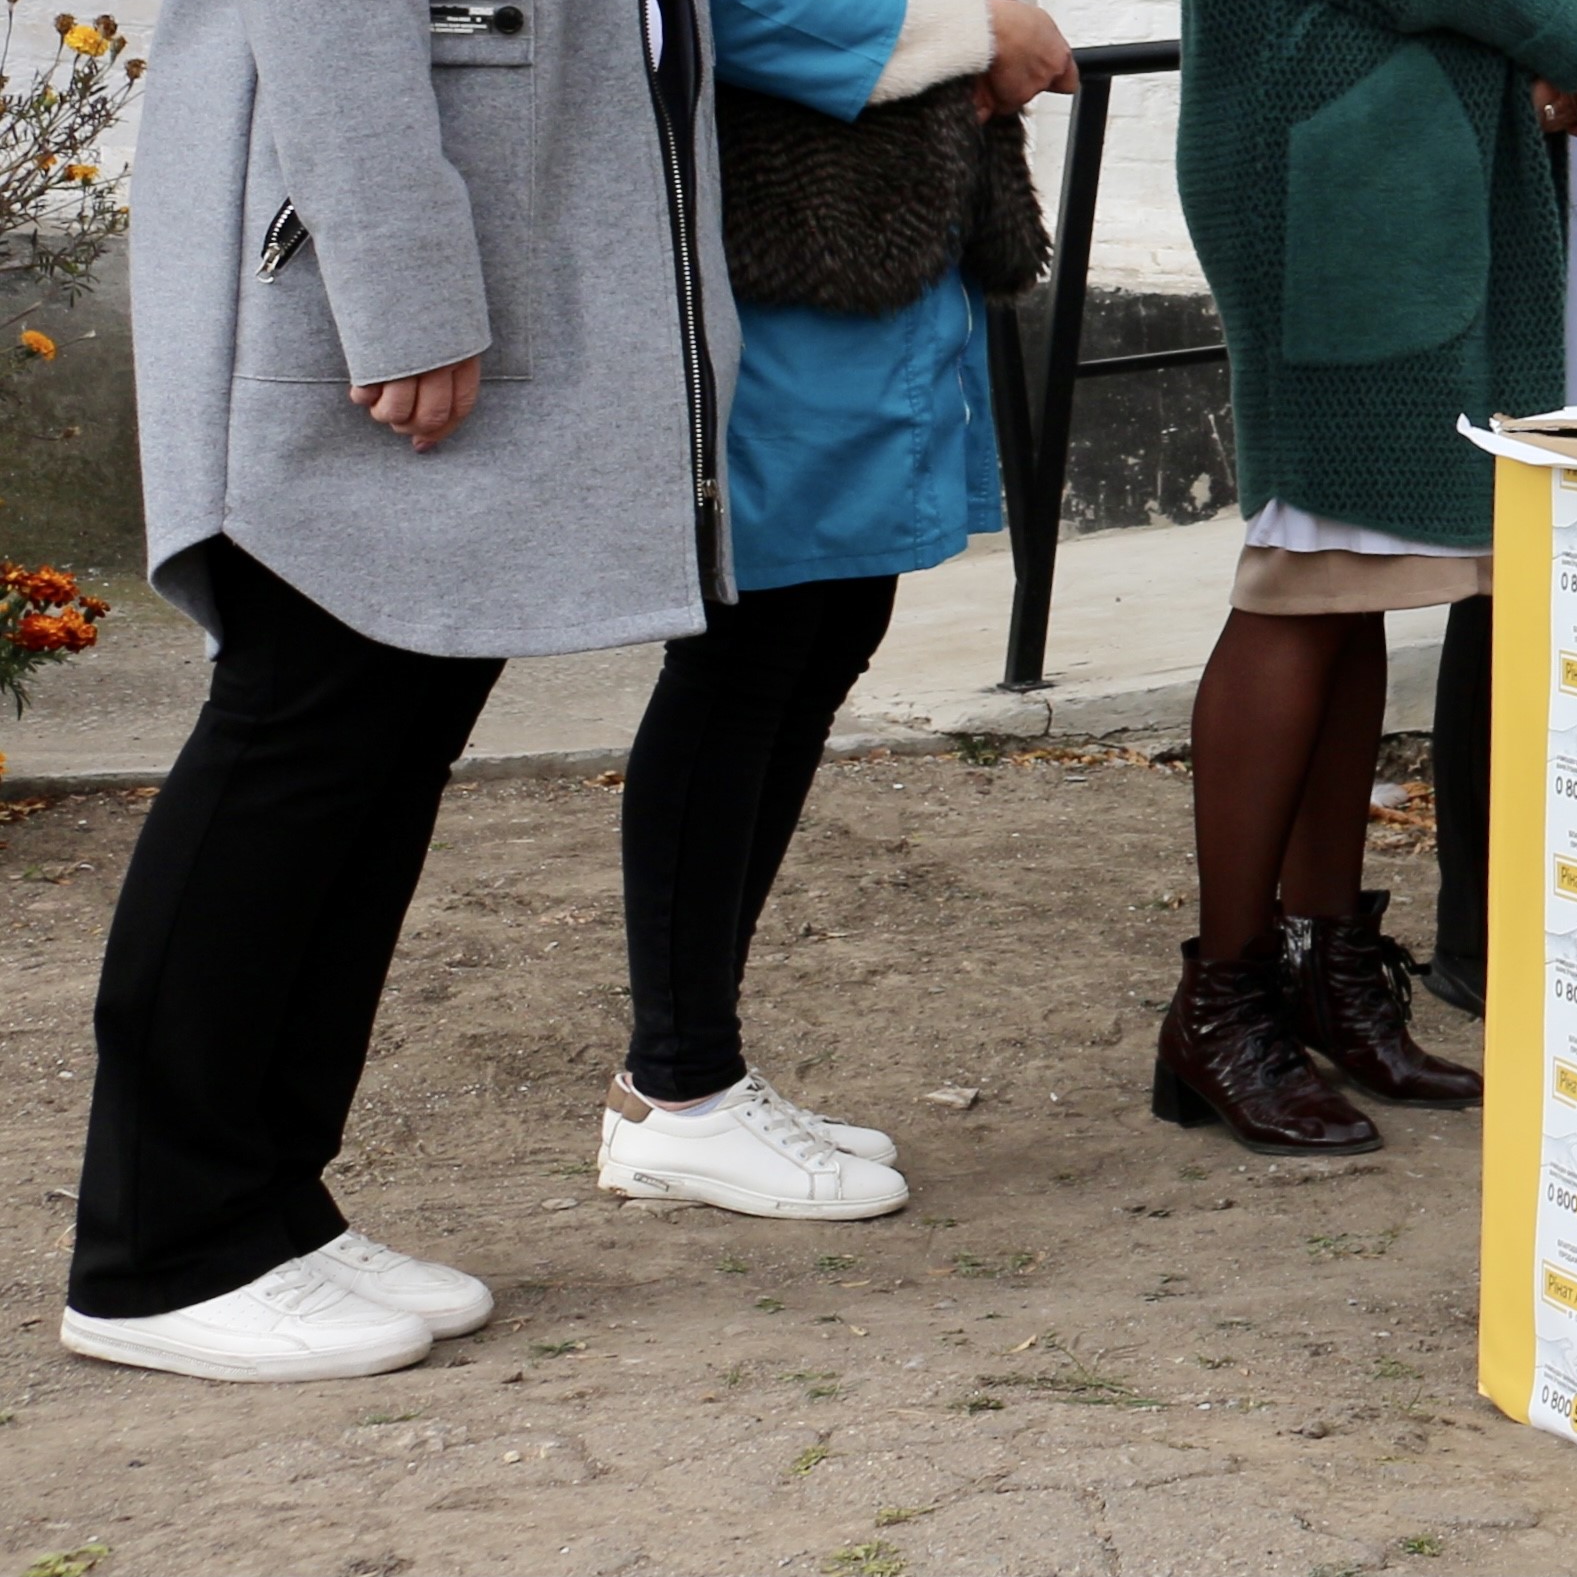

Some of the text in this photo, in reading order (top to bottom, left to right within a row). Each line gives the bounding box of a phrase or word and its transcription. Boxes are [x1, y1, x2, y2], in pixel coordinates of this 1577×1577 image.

[1561, 572, 1568, 591] 0
[1556, 776, 1563, 795] 0
[1555, 979, 1563, 998] 0
[1547, 1183, 1555, 1202] 0
[1547, 1274, 1573, 1301] Рінат
[1542, 1385, 1549, 1404] 0
[1550, 1390, 1572, 1417] 800
